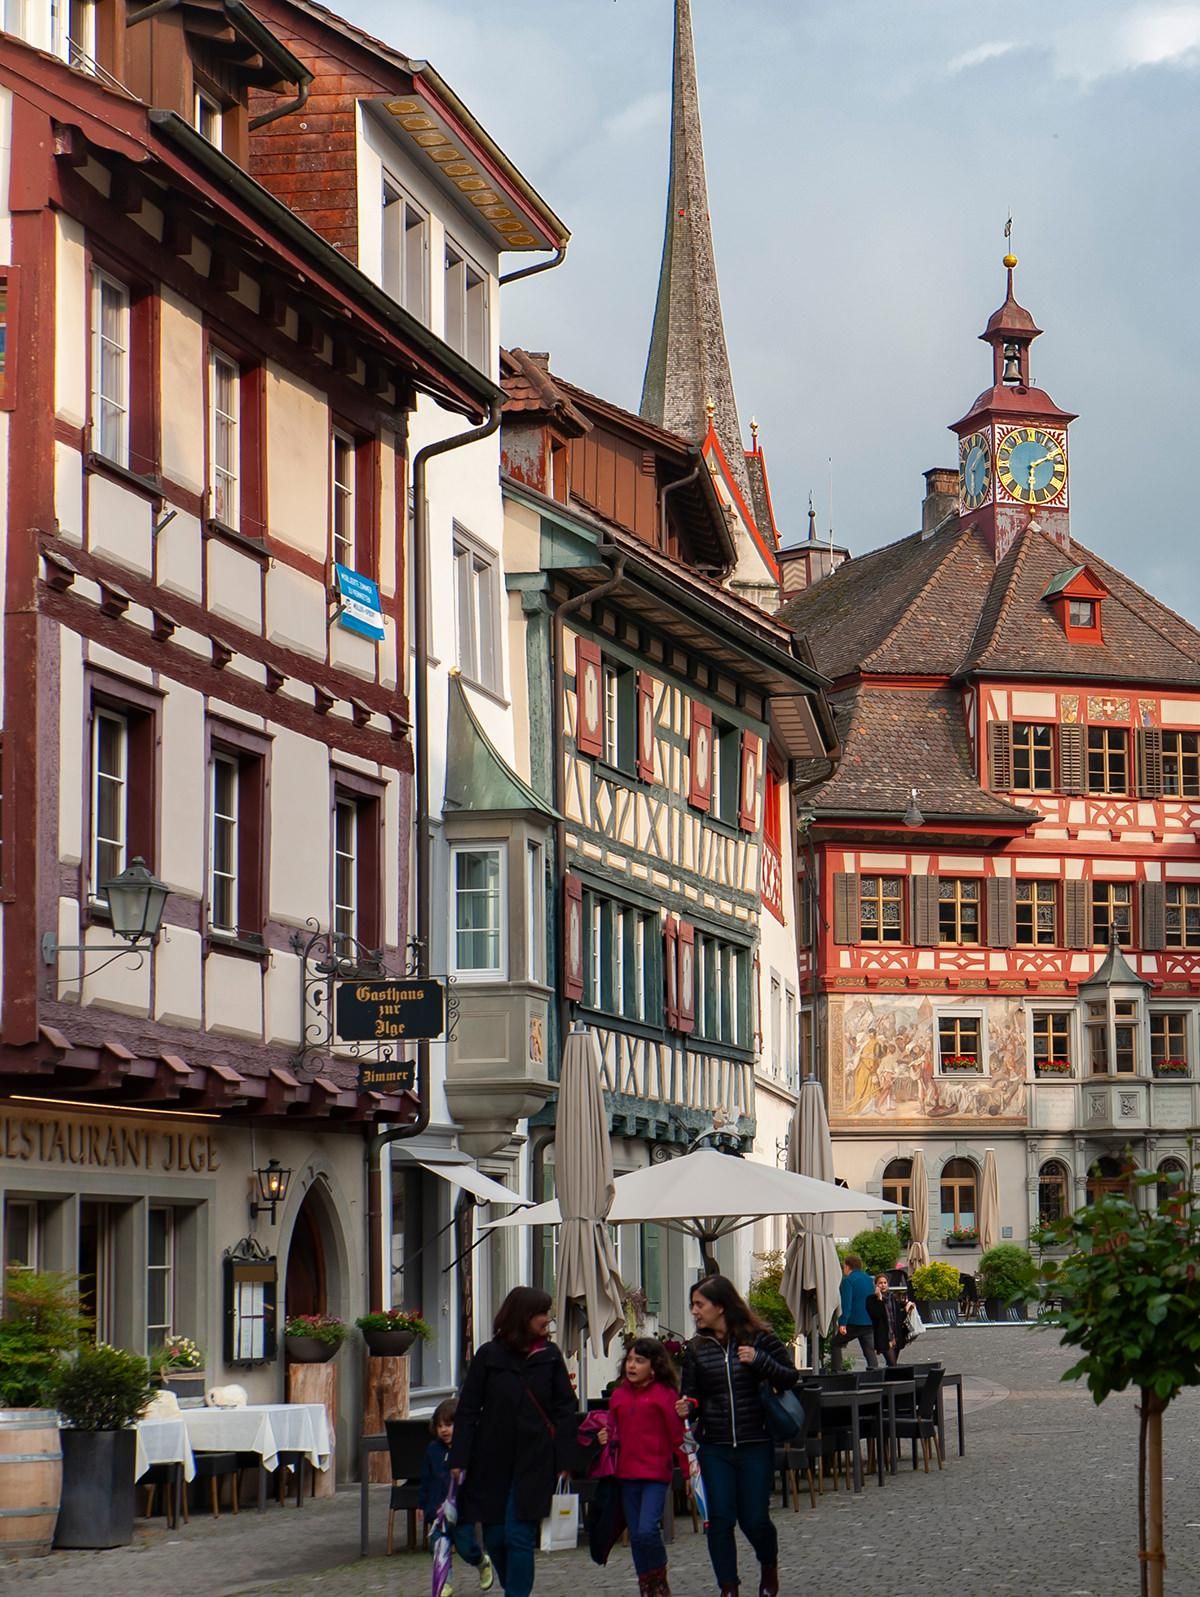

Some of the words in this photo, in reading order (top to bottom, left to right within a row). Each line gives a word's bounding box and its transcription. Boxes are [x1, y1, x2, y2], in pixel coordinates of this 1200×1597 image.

[355, 985, 425, 1003] Gasthaus
[378, 1004, 401, 1018] zur
[363, 1070, 409, 1085] Zimmer
